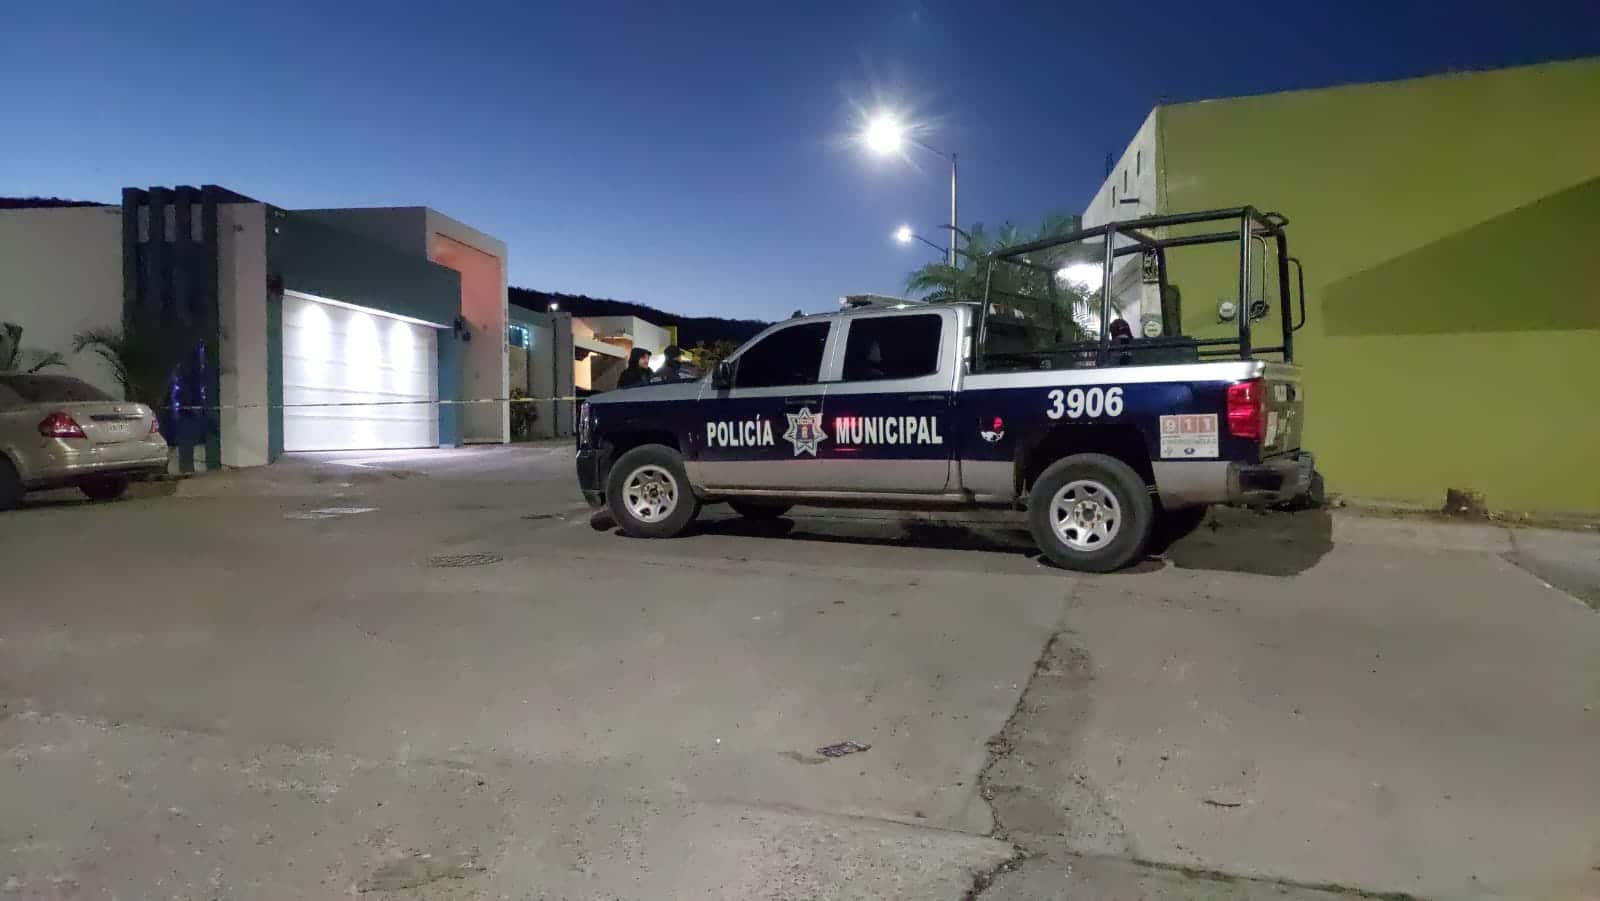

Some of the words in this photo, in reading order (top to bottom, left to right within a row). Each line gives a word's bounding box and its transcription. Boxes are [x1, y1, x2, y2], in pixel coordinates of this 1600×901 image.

[1047, 387, 1124, 419] 3906
[707, 414, 774, 447] POLICÍA
[835, 416, 943, 445] MUNICIPAL
